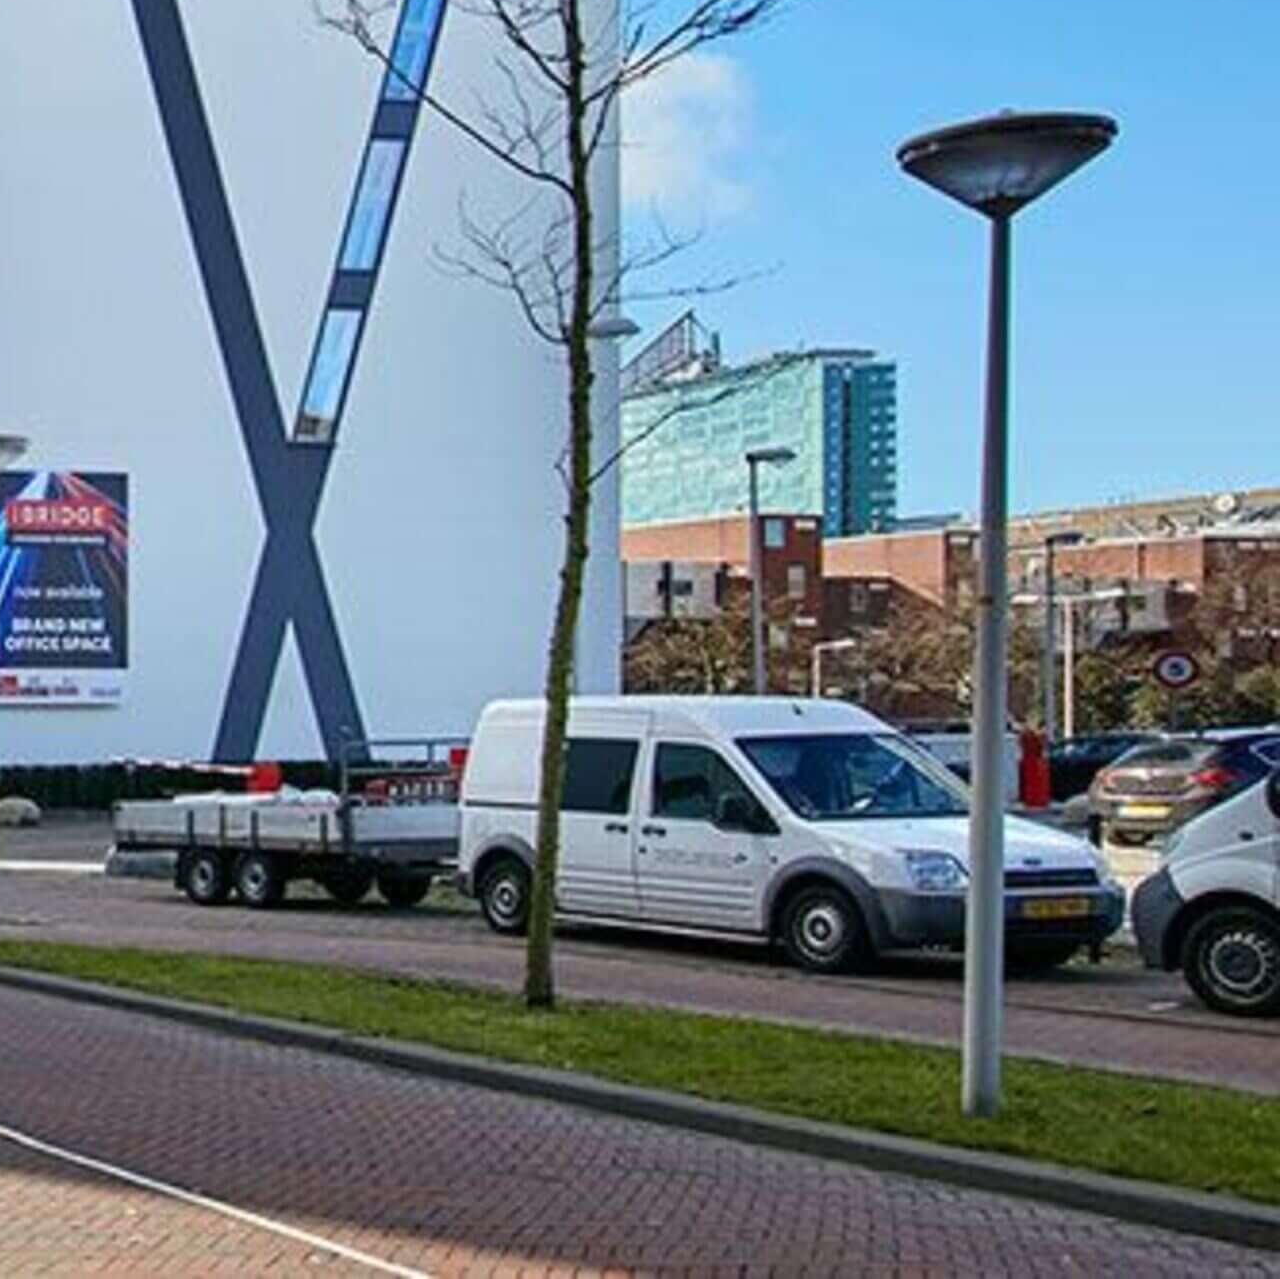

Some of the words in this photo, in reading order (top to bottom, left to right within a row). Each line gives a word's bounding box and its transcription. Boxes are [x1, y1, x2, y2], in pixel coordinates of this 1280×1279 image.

[21, 505, 104, 527] BRIDGE
[11, 617, 64, 633] BRAND
[69, 617, 105, 633] NEW
[4, 636, 59, 652] OFFICE
[62, 636, 112, 652] SPACE
